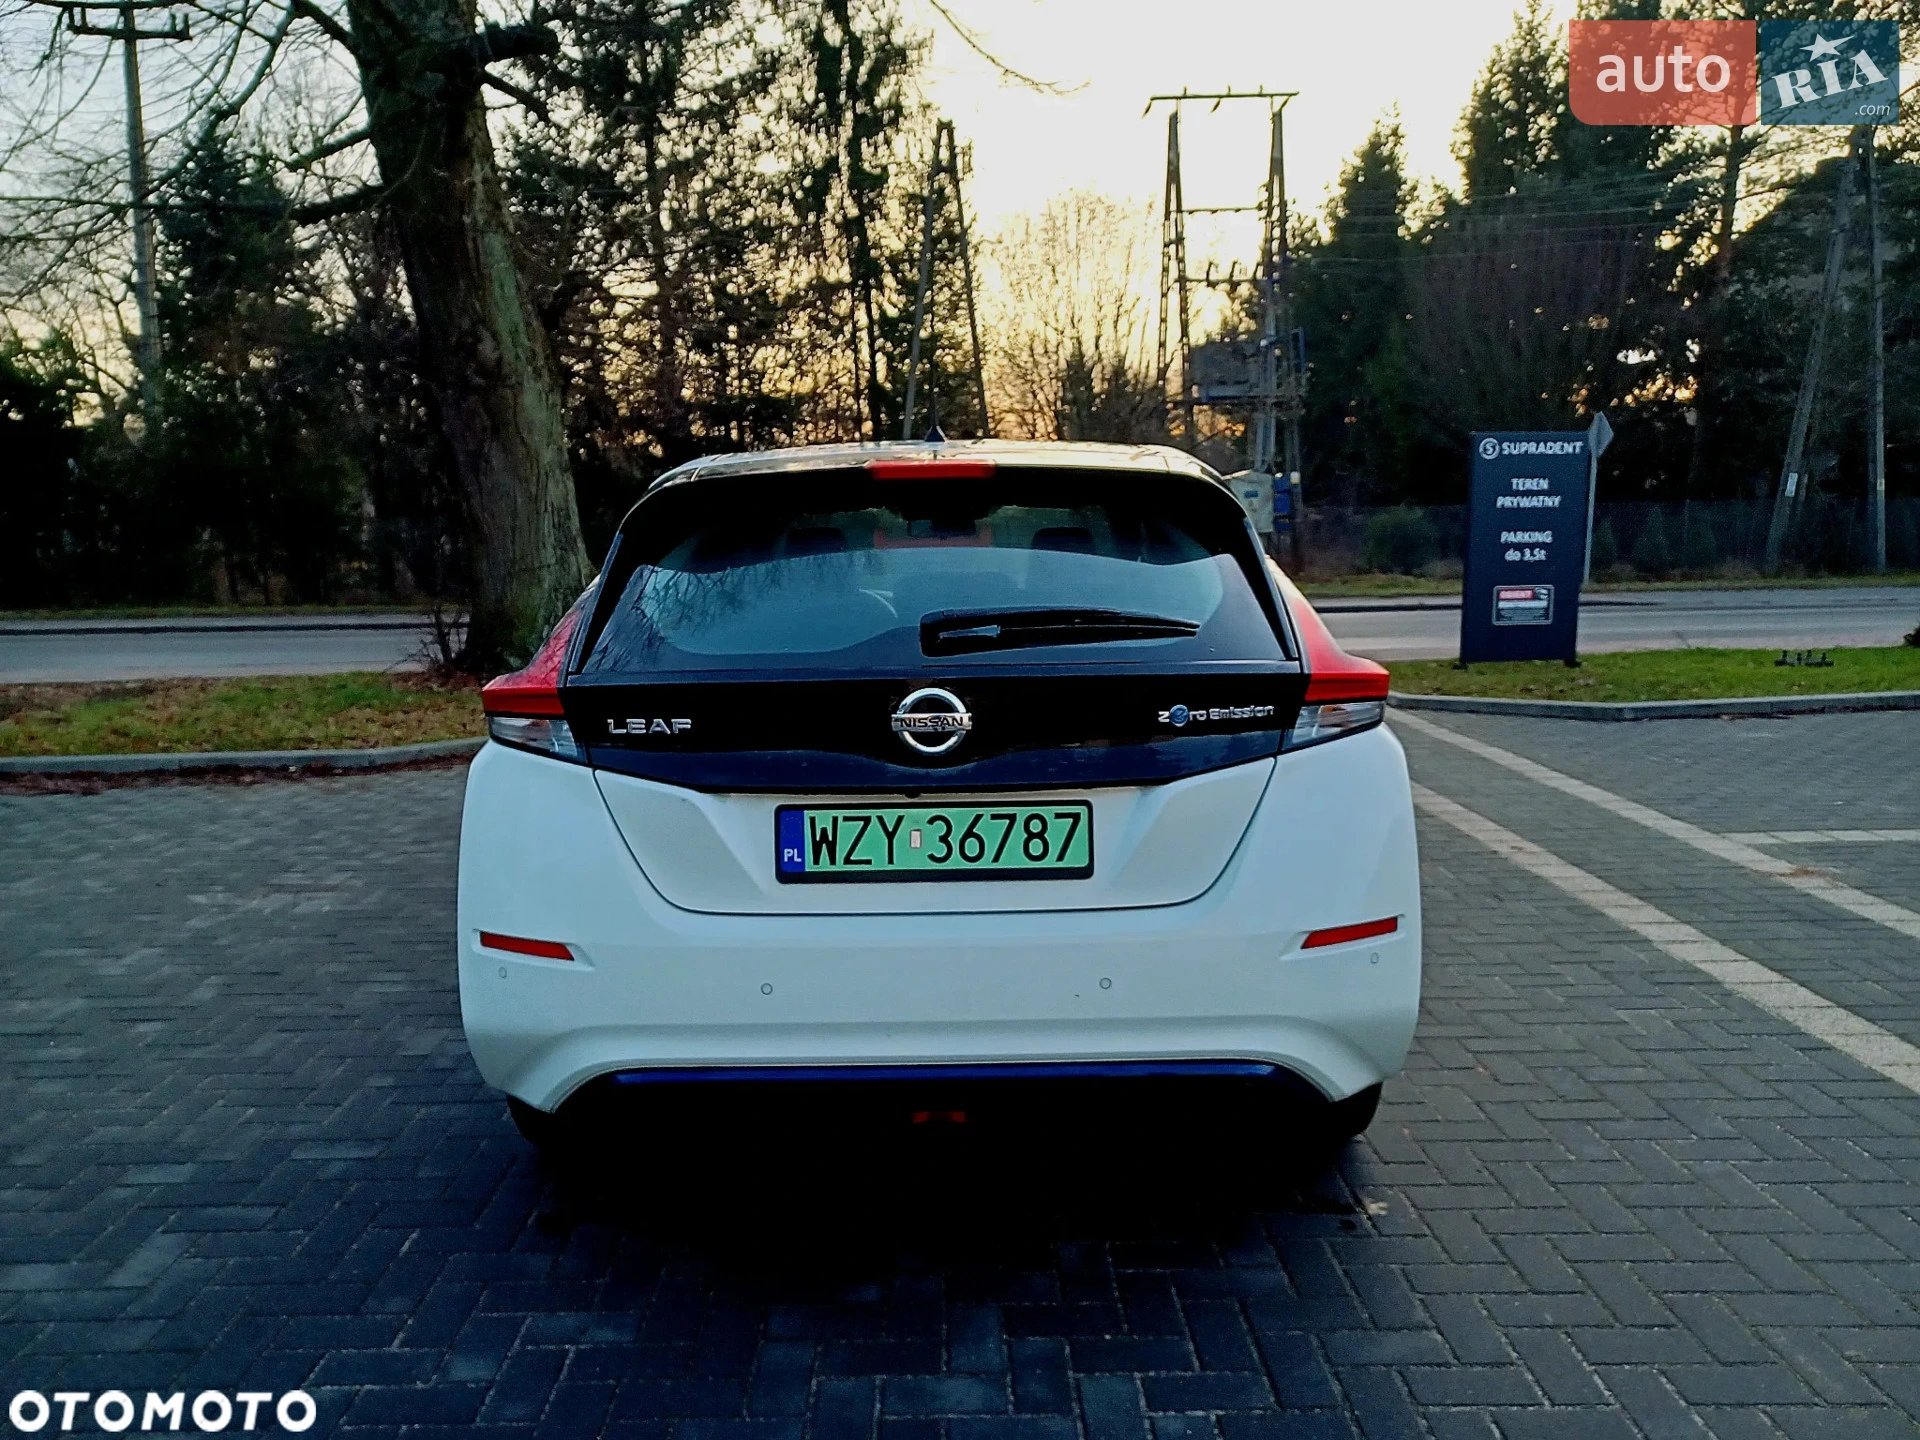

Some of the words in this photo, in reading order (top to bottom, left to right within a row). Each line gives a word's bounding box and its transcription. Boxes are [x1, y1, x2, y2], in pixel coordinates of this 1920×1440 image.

[1501, 441, 1584, 455] SUPRADENT
[1510, 478, 1549, 491] TEREN
[1496, 495, 1561, 508] PRYWATNY
[1501, 530, 1553, 544] PARKING
[1505, 548, 1521, 561] do
[1209, 705, 1275, 720] Emission
[607, 718, 692, 735] LEAF
[900, 715, 964, 728] NISSAN
[808, 814, 905, 866] WZY
[926, 811, 1082, 864] 36787
[783, 849, 802, 863] PL
